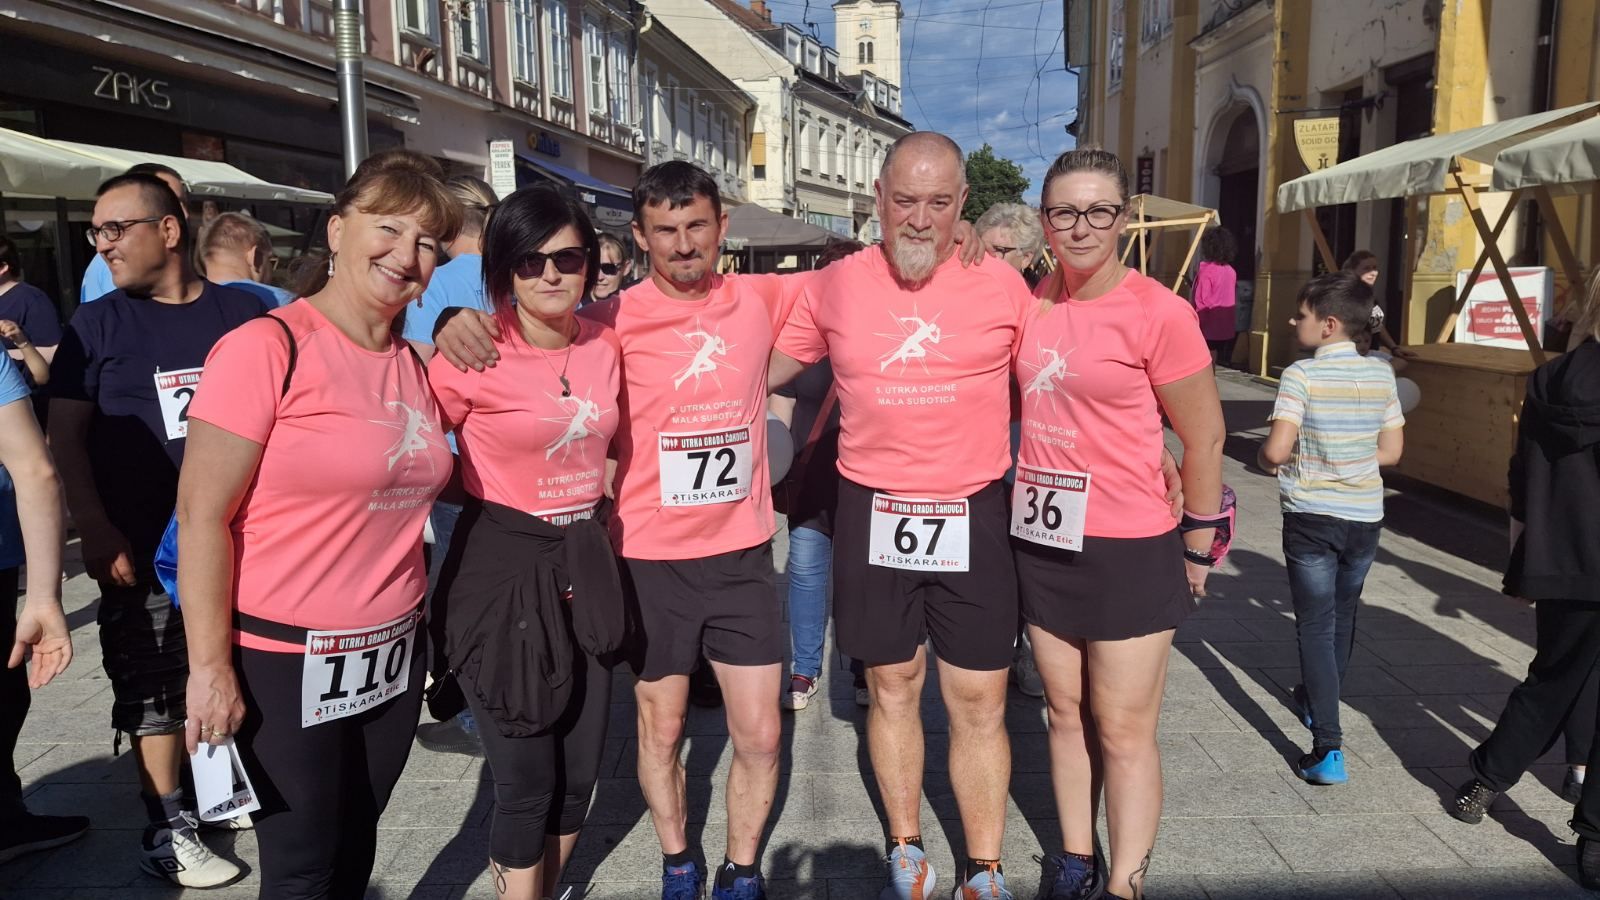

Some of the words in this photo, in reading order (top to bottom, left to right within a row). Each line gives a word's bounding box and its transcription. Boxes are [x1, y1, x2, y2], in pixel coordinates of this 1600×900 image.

[92, 66, 171, 110] ZAKS
[1324, 136, 1337, 144] GO
[885, 385, 918, 394] UTRKA
[878, 397, 904, 406] MALA
[907, 395, 956, 405] SUBOTICA
[680, 402, 712, 413] UTRKA
[672, 416, 699, 425] MALA
[700, 410, 742, 423] SUBOTICA
[681, 438, 702, 449] UTRKA
[704, 434, 725, 446] GRADA
[687, 447, 738, 490] 72
[547, 474, 574, 486] UTRKA
[383, 487, 415, 497] UTRKA
[539, 489, 564, 499] MALA
[367, 501, 396, 511] MALA
[891, 502, 911, 512] UTRKA
[912, 504, 933, 514] GRADA
[1023, 485, 1062, 530] 36
[551, 513, 572, 526] UTRKA
[894, 517, 947, 556] 67
[1056, 535, 1073, 545] Etic
[940, 559, 960, 567] Etic
[338, 637, 366, 650] UTRKA
[367, 630, 390, 645] GRADA
[320, 637, 407, 702] 110
[384, 684, 400, 696] Etic
